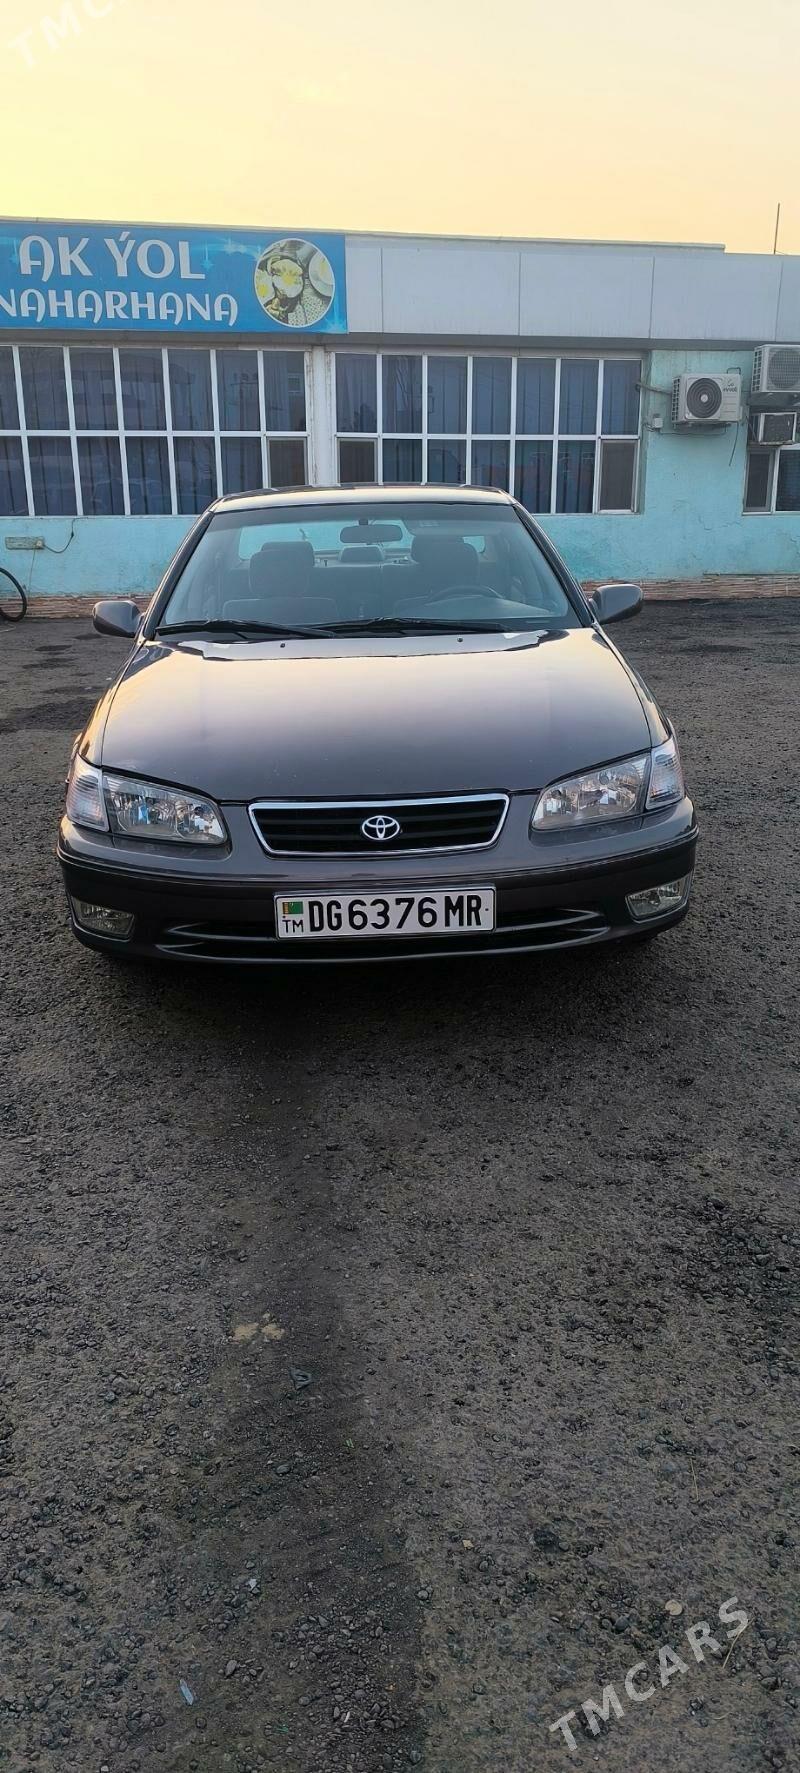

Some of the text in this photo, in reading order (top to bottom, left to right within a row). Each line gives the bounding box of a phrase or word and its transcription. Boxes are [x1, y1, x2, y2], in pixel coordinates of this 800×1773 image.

[19, 231, 206, 282] AK ÝOL
[282, 918, 304, 934] TM
